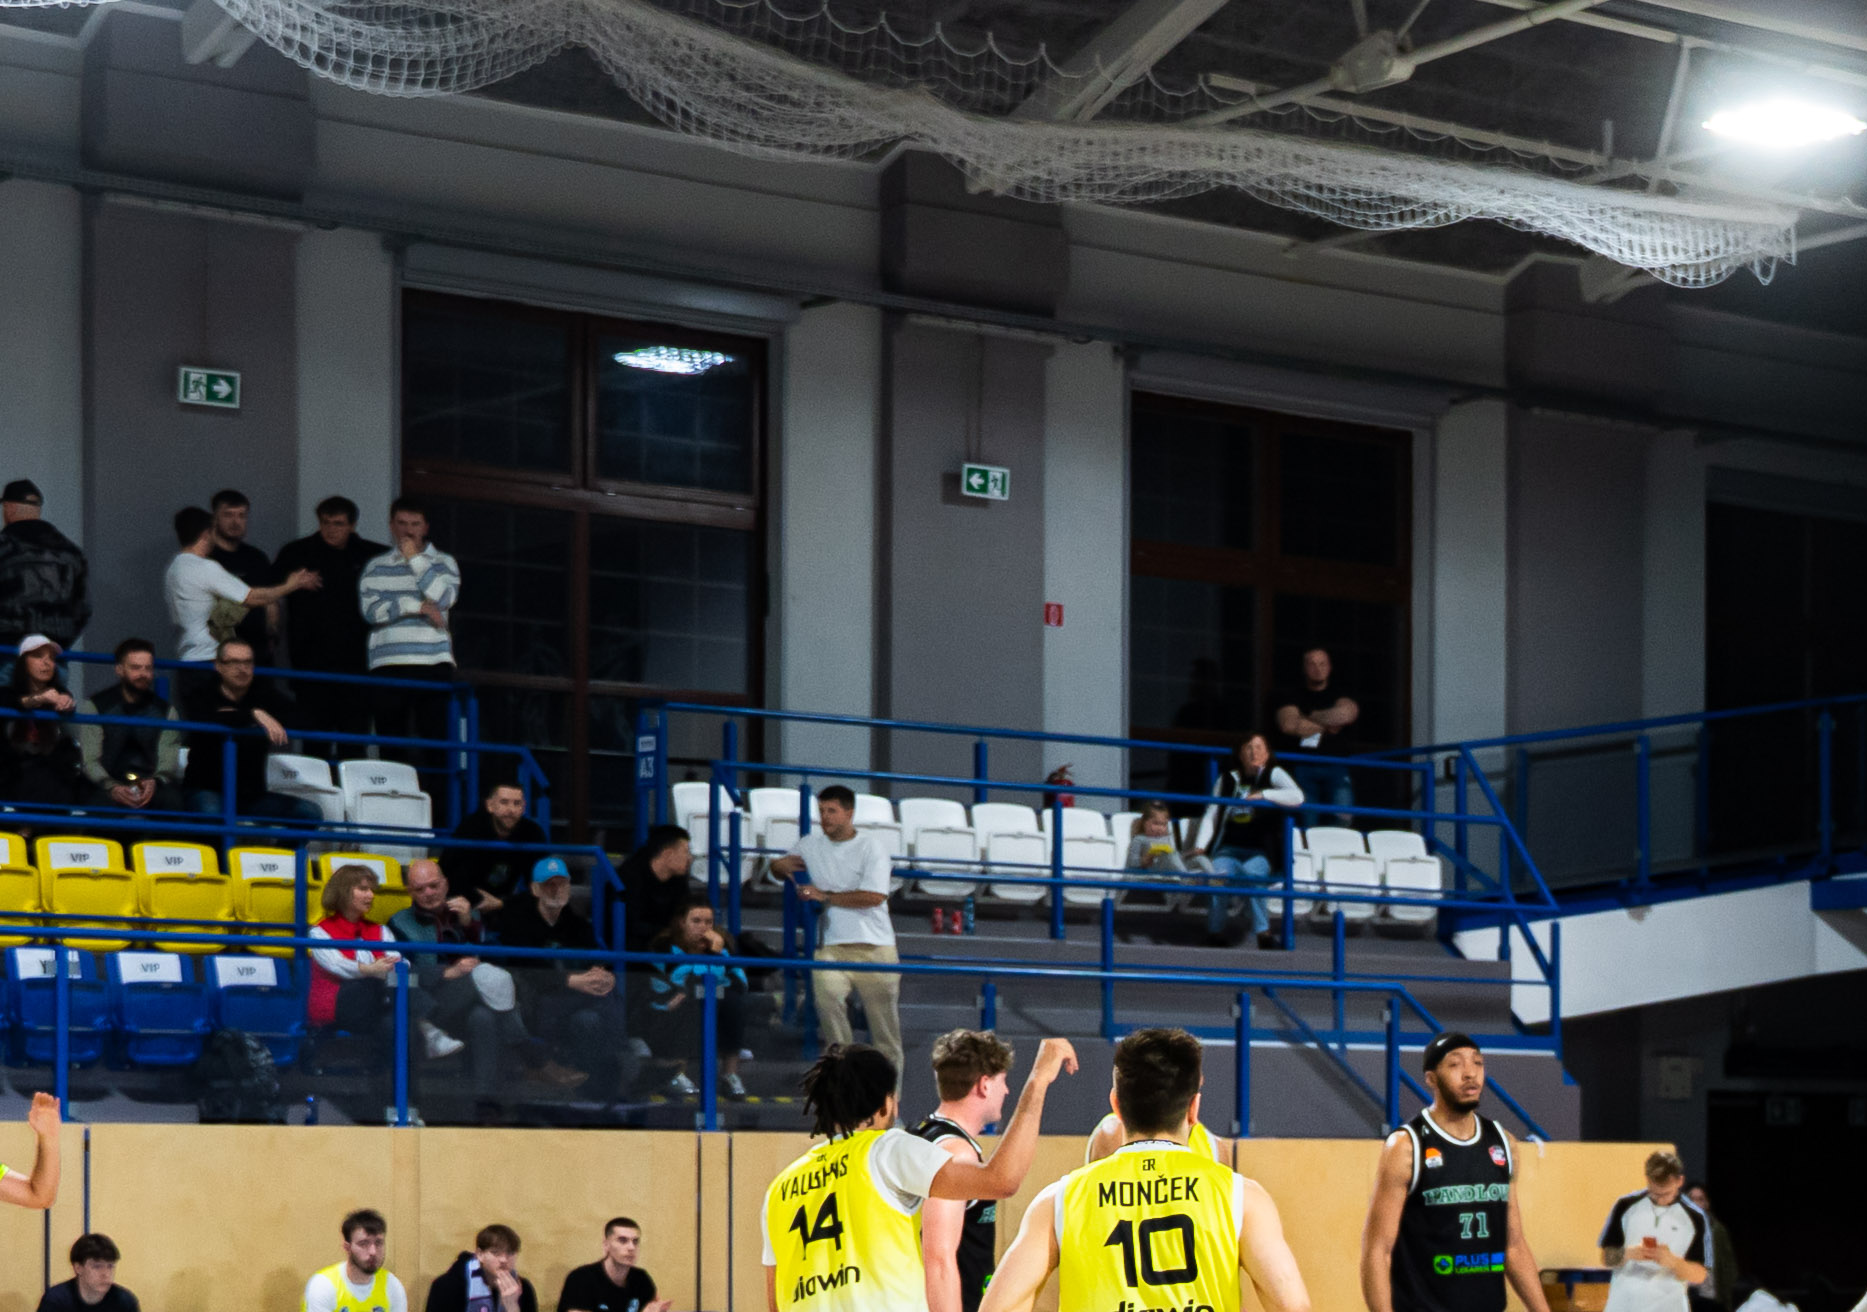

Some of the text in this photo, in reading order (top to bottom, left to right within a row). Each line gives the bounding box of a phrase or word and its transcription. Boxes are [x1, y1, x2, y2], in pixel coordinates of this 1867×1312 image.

[69, 853, 91, 864] VIP
[164, 855, 185, 866] VIP
[1098, 1173, 1200, 1208] MONČEK
[788, 1191, 844, 1262] 14
[1458, 1211, 1490, 1240] 71
[1103, 1213, 1199, 1288] 10
